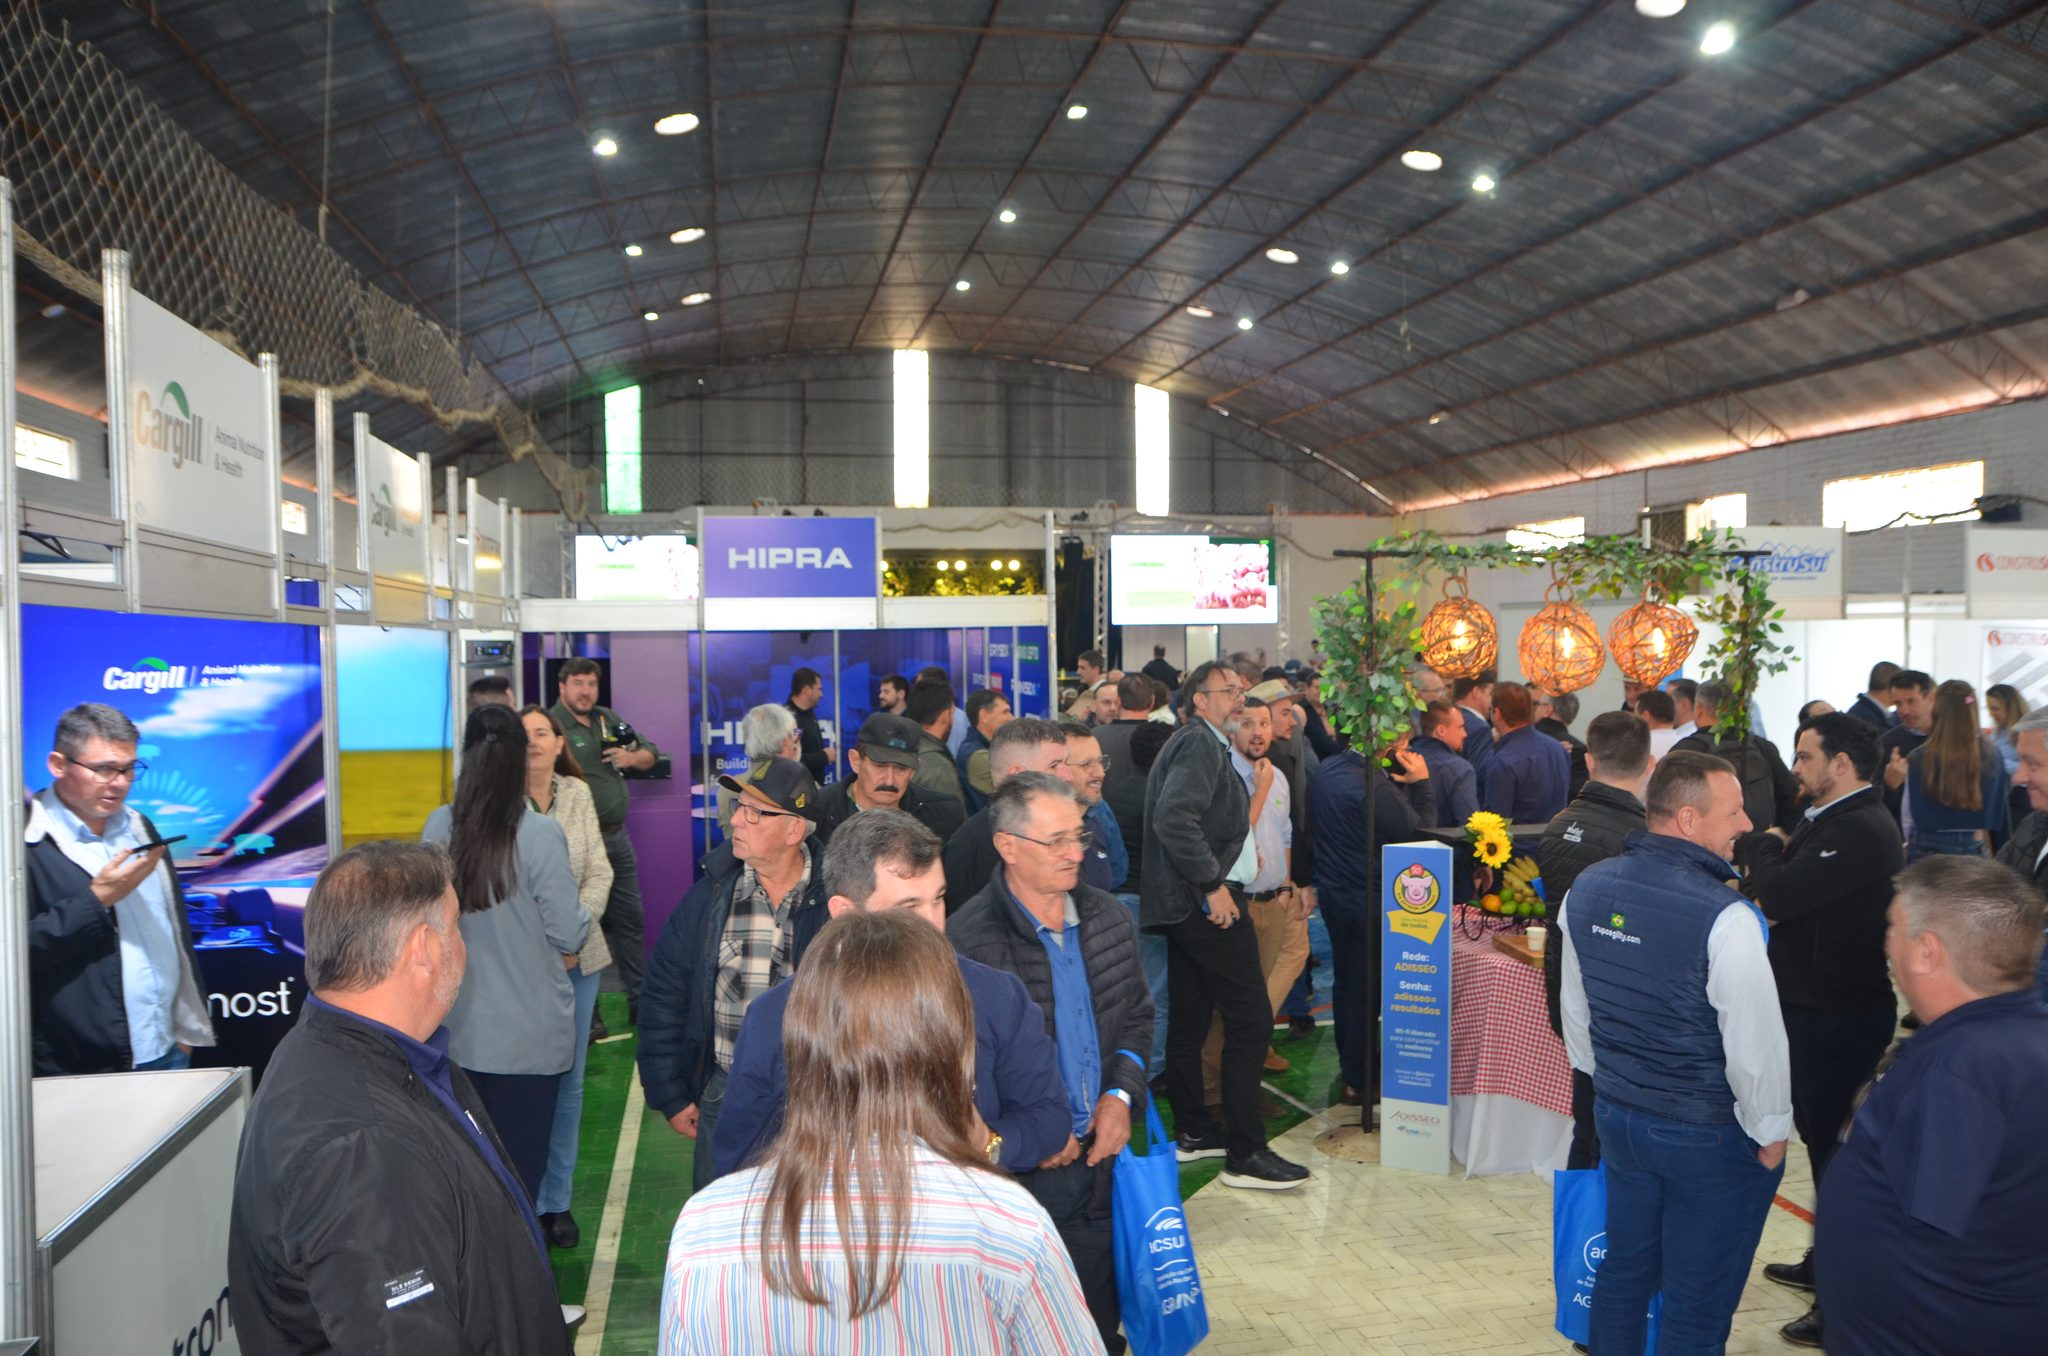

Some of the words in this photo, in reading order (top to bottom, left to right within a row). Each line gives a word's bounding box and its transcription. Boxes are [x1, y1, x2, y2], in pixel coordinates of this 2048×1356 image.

[136, 390, 203, 469] Cargill
[728, 547, 853, 570] HIPRA
[1730, 549, 1834, 574] nstruSul
[202, 665, 237, 675] Animal
[238, 664, 282, 674] Nutrition
[103, 665, 187, 694] Cargill
[200, 677, 209, 687] &
[211, 677, 244, 687] Health
[701, 719, 837, 746] HIA
[716, 758, 752, 770] Buildi
[1402, 951, 1430, 962] Rede:
[1395, 962, 1437, 974] ADISSEO
[1399, 980, 1432, 992] Senha:
[207, 981, 292, 1018] nost
[1391, 1004, 1440, 1015] resultados
[1390, 1110, 1440, 1125] ADISSEO
